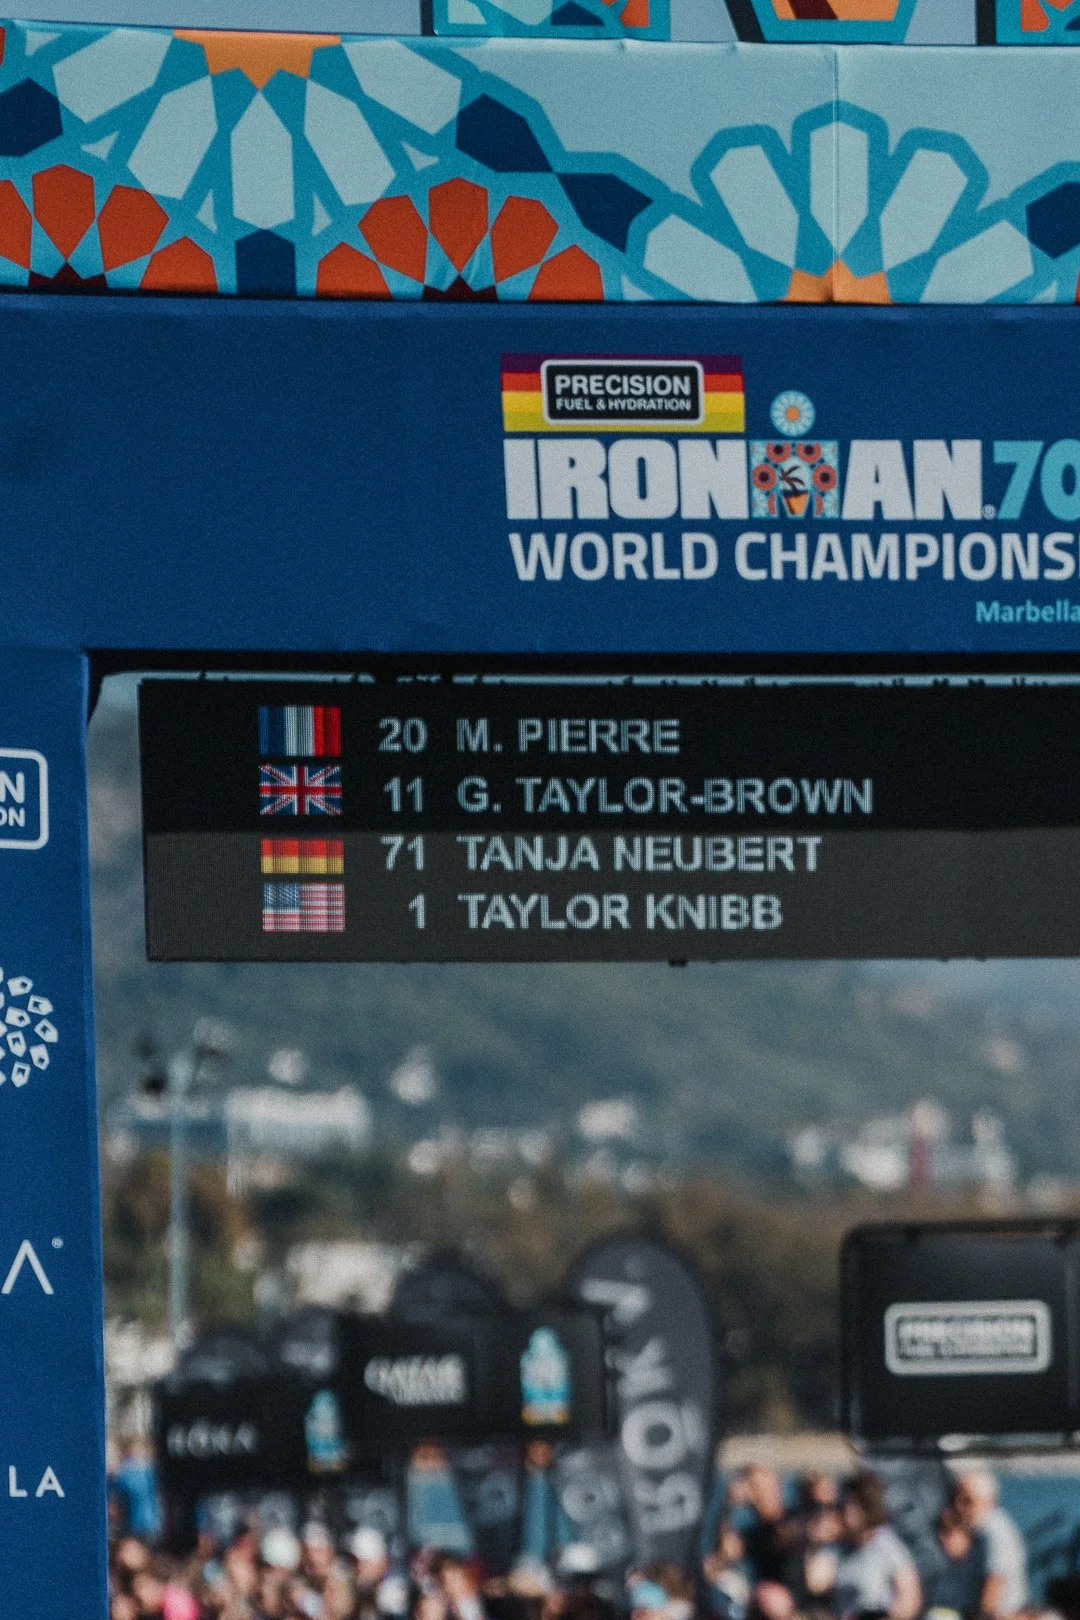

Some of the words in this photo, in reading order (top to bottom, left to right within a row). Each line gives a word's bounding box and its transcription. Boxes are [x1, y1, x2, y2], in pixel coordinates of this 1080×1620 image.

[554, 374, 691, 396] PRECISION
[556, 398, 593, 411] FUEL
[595, 398, 608, 411] &
[608, 398, 692, 412] HYDRATION
[509, 531, 719, 581] WORLD
[377, 718, 428, 754] 20
[455, 718, 503, 754] M.
[517, 718, 681, 754] PIERRE
[383, 777, 426, 812] 11
[456, 777, 501, 814] G.
[516, 777, 874, 814] TAYLOR-BROWN
[381, 835, 427, 871] 71
[456, 835, 601, 872] TANJA
[613, 835, 824, 872] NEUBERT
[408, 895, 427, 930] 1
[457, 894, 631, 930] TAYLOR
[646, 894, 783, 930] KNIBB
